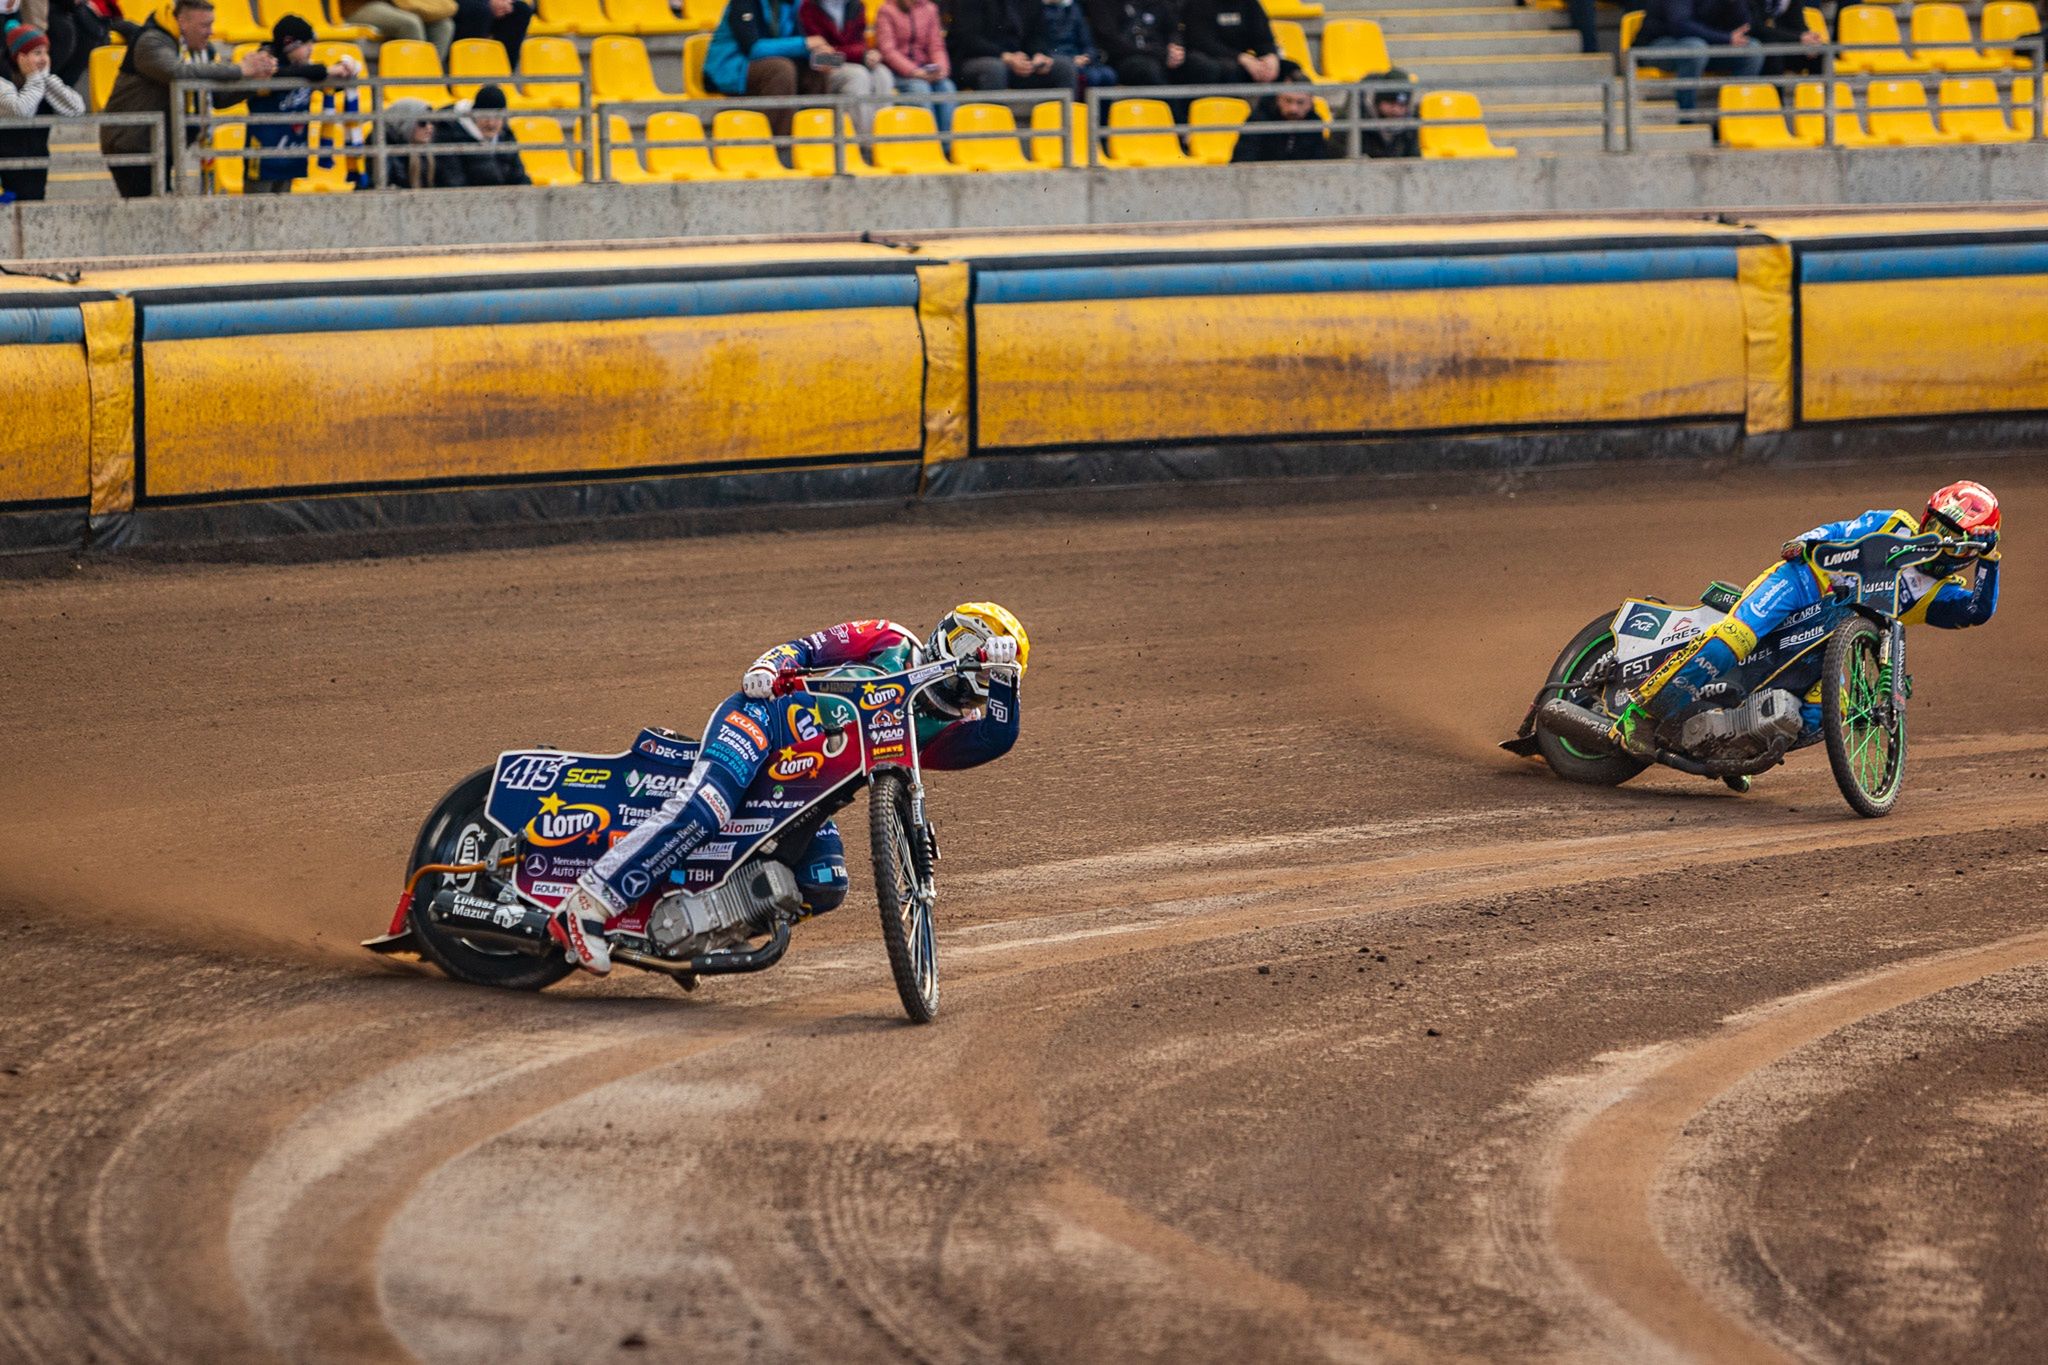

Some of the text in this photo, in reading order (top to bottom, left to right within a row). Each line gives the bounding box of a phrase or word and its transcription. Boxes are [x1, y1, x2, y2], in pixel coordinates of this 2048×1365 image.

[1823, 549, 1860, 567] LAVOR
[1630, 619, 1655, 632] PGE
[1622, 656, 1653, 678] FST
[867, 688, 897, 705] LOTTO
[730, 714, 764, 746] KUKA
[717, 733, 749, 761] Leszno
[719, 724, 759, 763] Transbud
[500, 755, 578, 791] 415
[780, 757, 815, 775] LOTTO
[563, 768, 612, 784] SGP
[542, 812, 595, 838] LOTTO
[687, 870, 714, 882] TBH
[452, 904, 490, 920] Mazur
